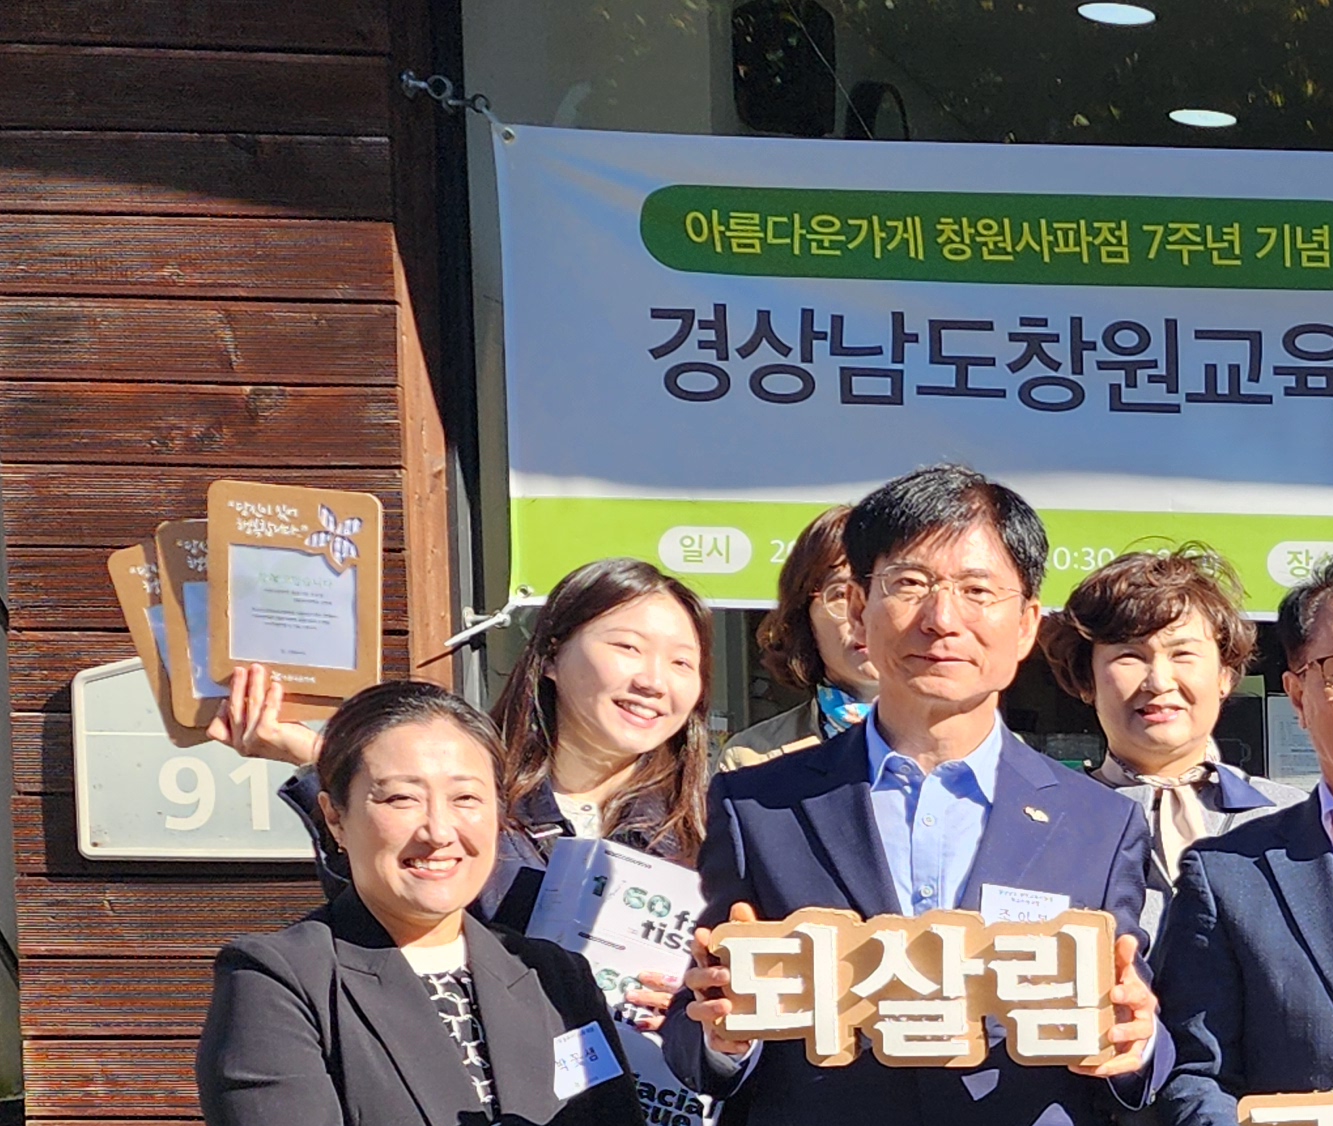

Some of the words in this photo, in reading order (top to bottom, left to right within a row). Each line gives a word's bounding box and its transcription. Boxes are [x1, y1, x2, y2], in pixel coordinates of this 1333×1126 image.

[685, 208, 925, 262] 아름다운가게
[936, 213, 1132, 265] 창원사파점
[1142, 221, 1243, 266] 7주년
[1256, 223, 1332, 269] 기념
[679, 534, 732, 566] 일시
[1046, 546, 1115, 570] 0:30
[158, 756, 271, 831] 91
[721, 924, 1099, 1057] 되살림
